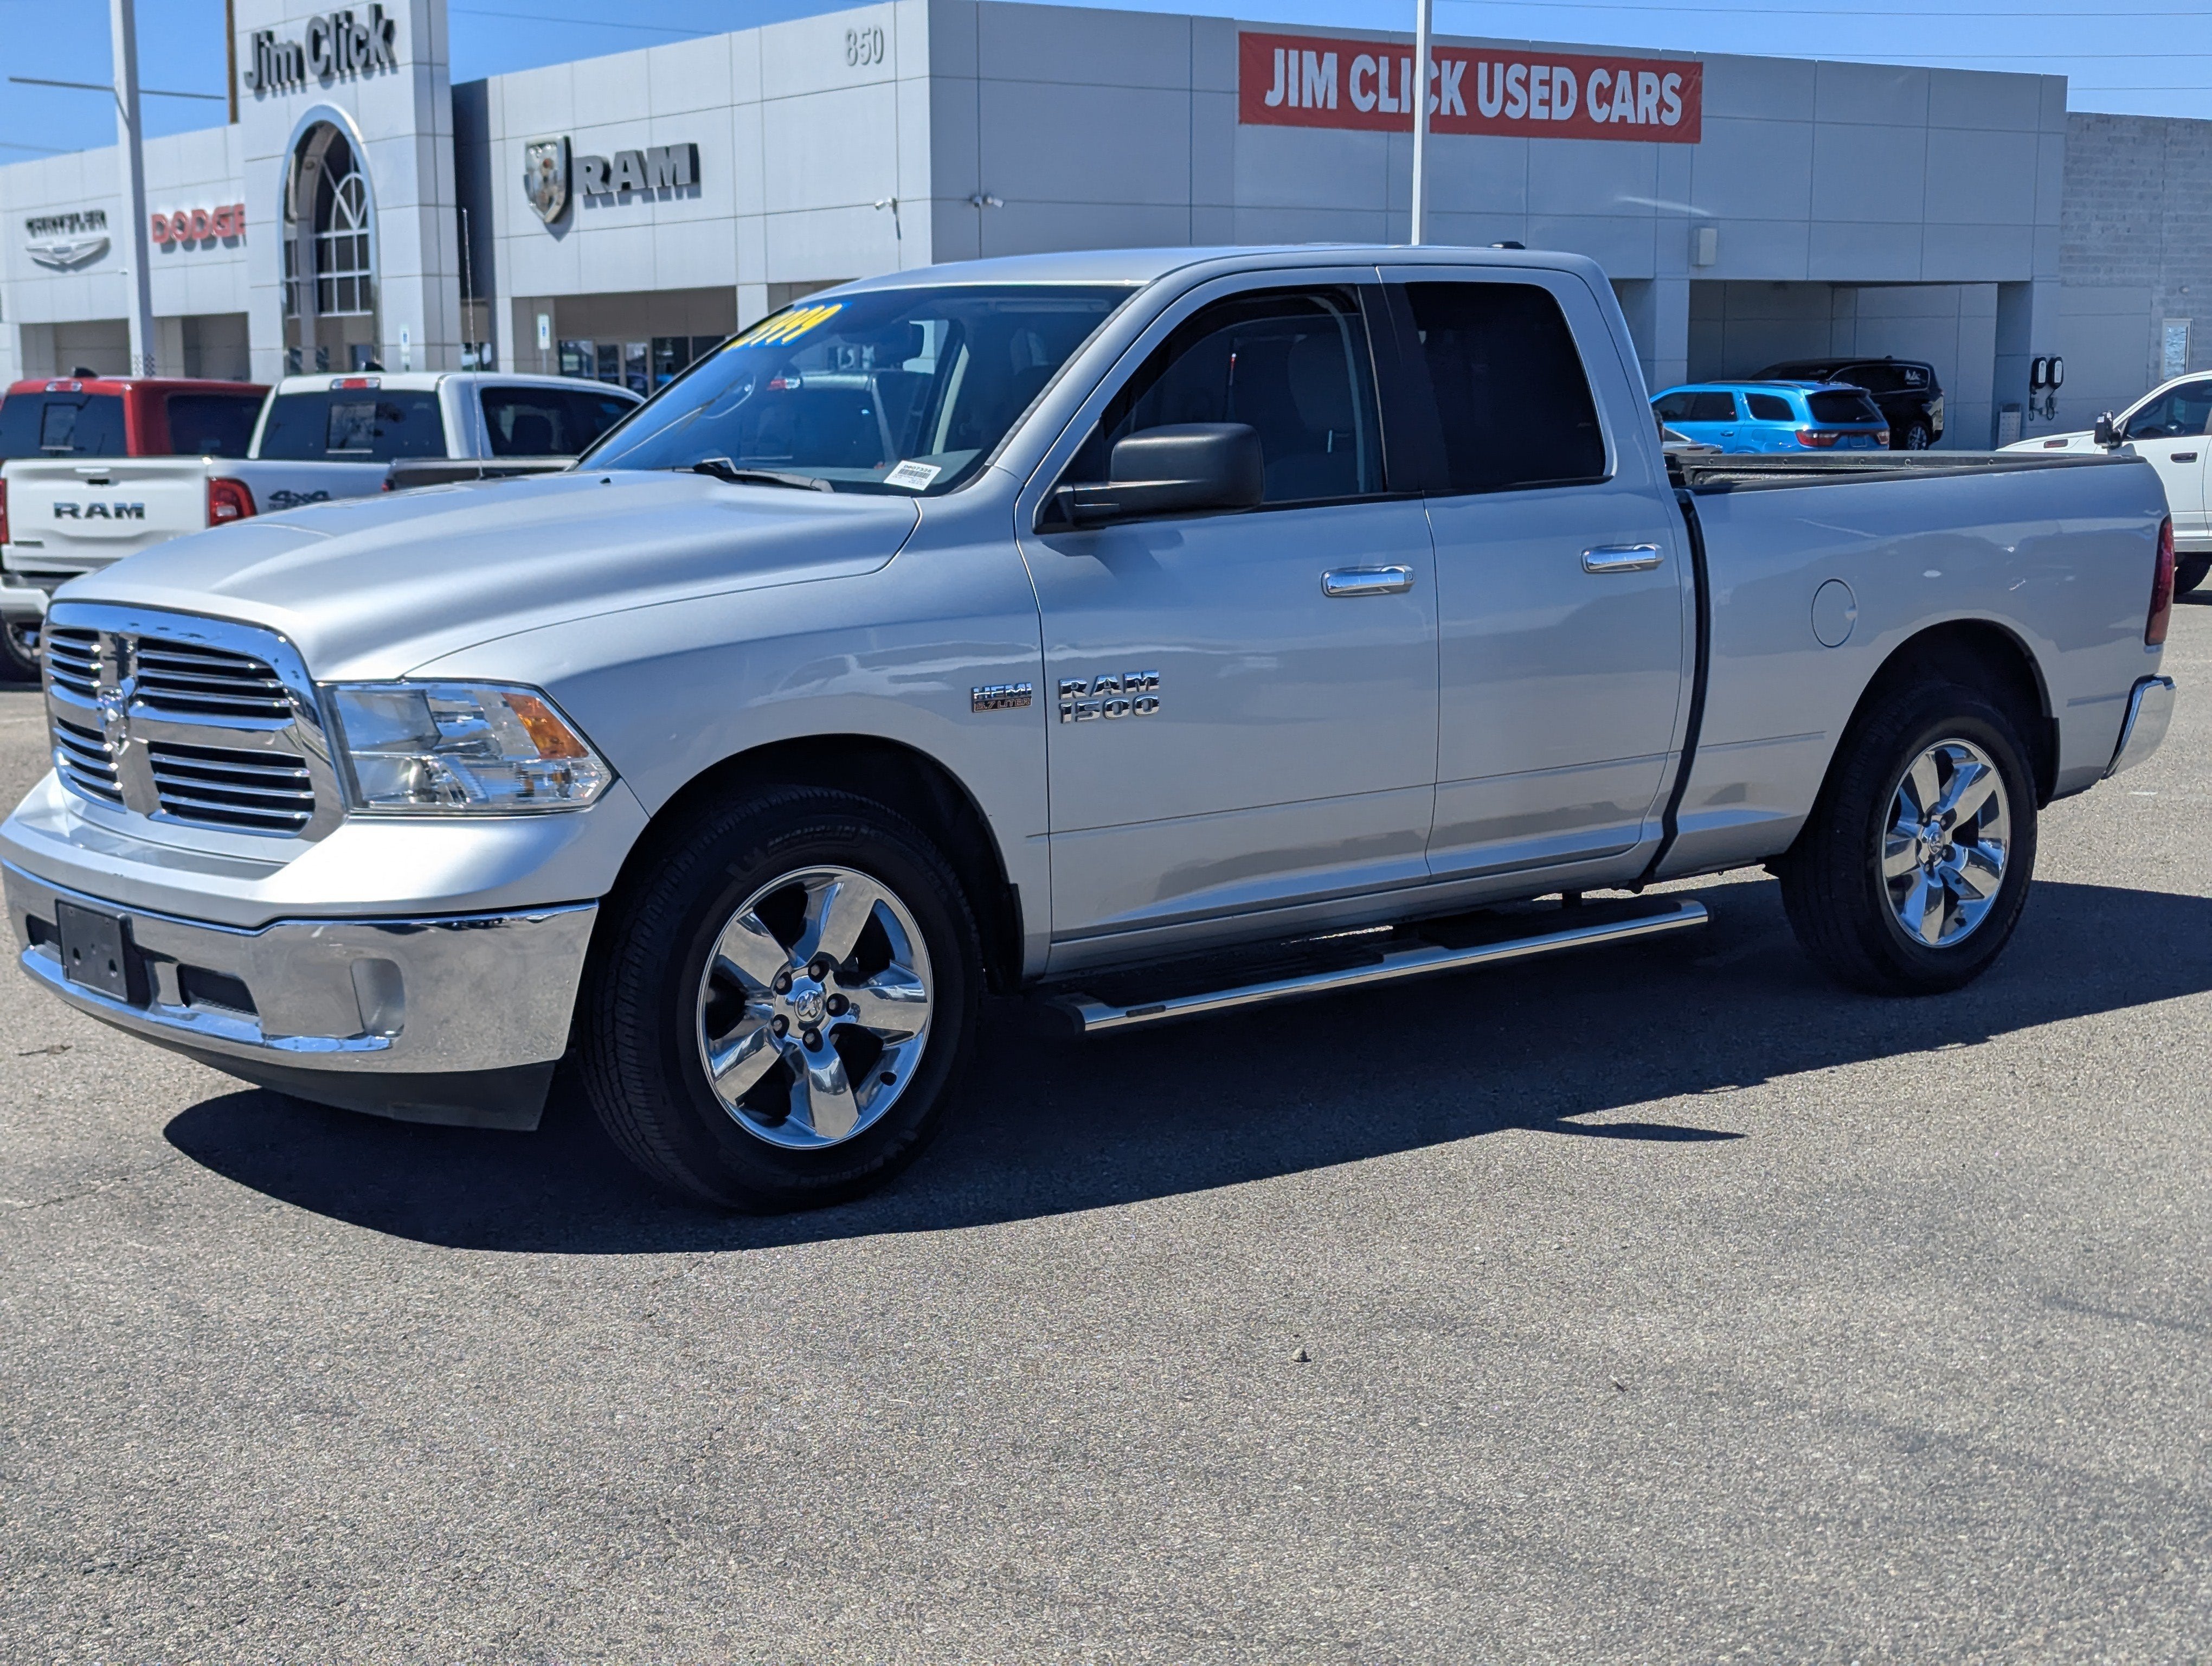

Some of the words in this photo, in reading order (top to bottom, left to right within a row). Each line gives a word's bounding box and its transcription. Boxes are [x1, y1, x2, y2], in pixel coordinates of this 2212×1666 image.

[244, 31, 304, 90] Jim
[306, 3, 396, 76] Click
[846, 27, 884, 66] 850
[1264, 48, 1338, 110] JIM
[1477, 62, 1578, 120] USED
[1586, 68, 1682, 126] CARS
[573, 143, 699, 194] RAM
[152, 203, 245, 244] DODGE
[54, 502, 146, 520] RAM
[972, 682, 1032, 700] HEMI
[1059, 670, 1159, 700] RAM
[976, 701, 996, 710] 5.7
[997, 697, 1031, 708] LITER
[1059, 694, 1160, 723] 1500
